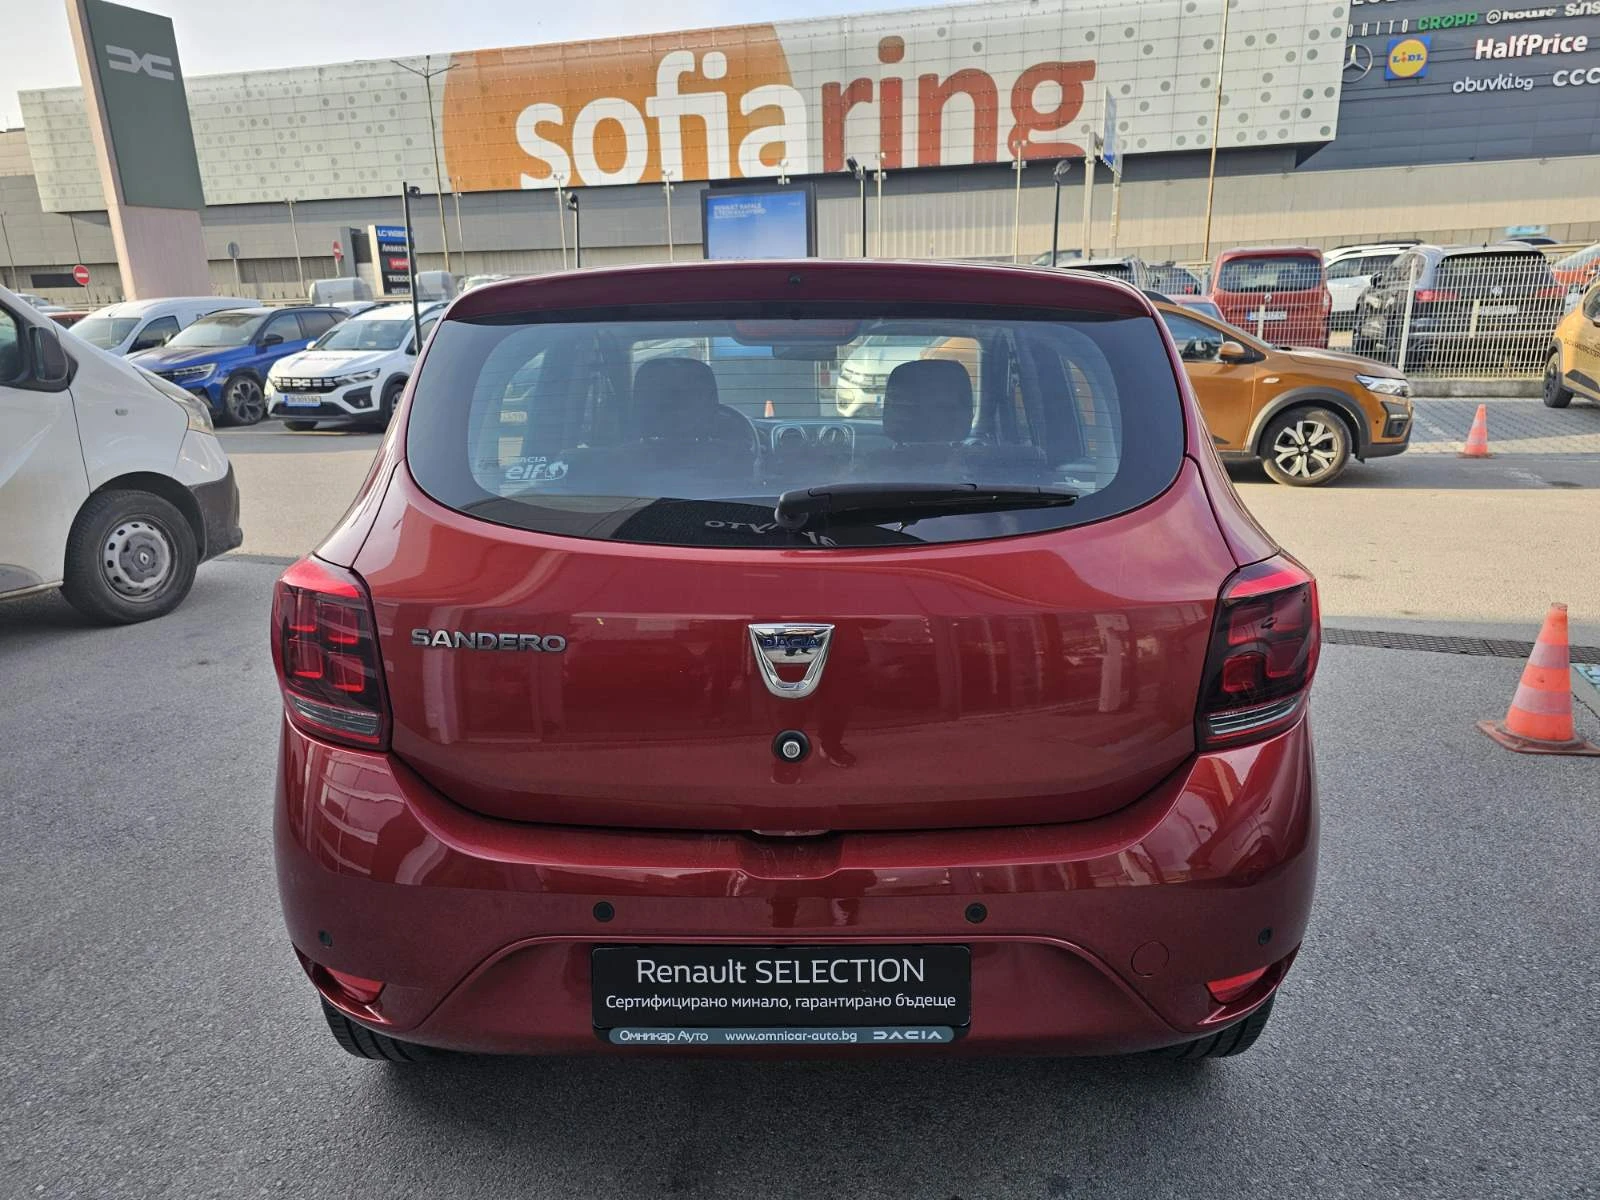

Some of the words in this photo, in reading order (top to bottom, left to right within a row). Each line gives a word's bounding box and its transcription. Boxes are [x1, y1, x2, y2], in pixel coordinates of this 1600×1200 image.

[1417, 12, 1478, 31] CROPP
[1474, 33, 1589, 60] HalfPrice
[1452, 73, 1534, 94] obuvki.bg
[1552, 67, 1600, 87] CCC
[504, 463, 547, 480] elf
[411, 628, 567, 652] SANDERO
[762, 636, 819, 649] DACIA
[636, 959, 747, 984] Renault
[755, 958, 925, 984] SELECTION
[605, 994, 728, 1011] Сертифицирано
[731, 997, 792, 1011] минало,
[795, 997, 892, 1011] гарантирано
[895, 993, 956, 1009] бъдеще
[619, 1030, 675, 1043] Омникар
[677, 1030, 709, 1043] Ауто
[725, 1030, 858, 1043] www.omnicar-auto.bg
[873, 1030, 943, 1040] DACIA
